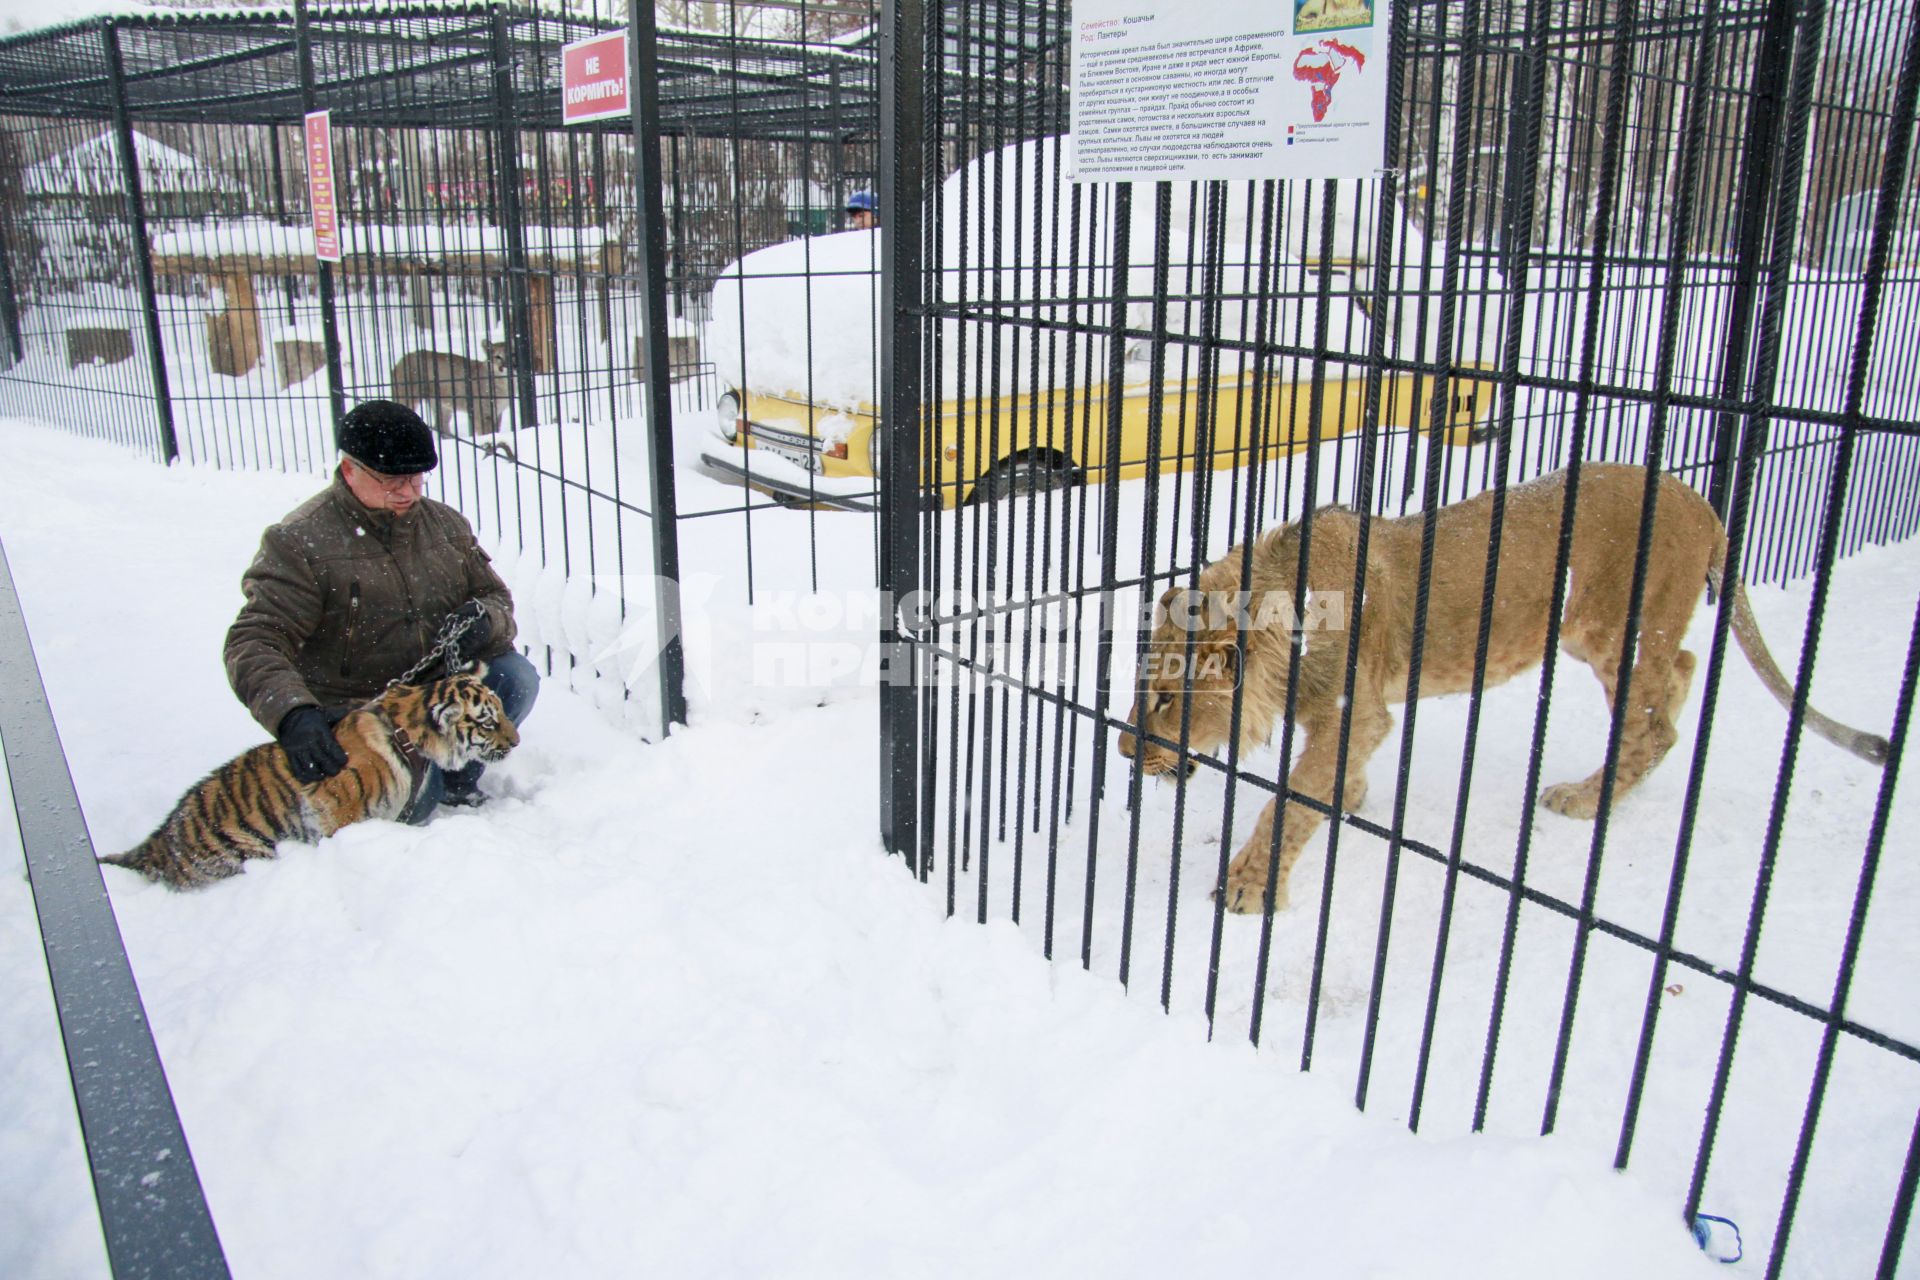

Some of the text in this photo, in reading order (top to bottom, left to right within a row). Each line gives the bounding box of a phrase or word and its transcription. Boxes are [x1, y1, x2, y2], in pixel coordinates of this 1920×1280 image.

[1123, 14, 1154, 24] Кошачьи
[1098, 30, 1128, 40] Пантеры
[1080, 48, 1120, 58] Исторический
[1121, 46, 1138, 54] ареал
[1172, 38, 1213, 48] значительно
[1215, 36, 1232, 44] шире
[1234, 30, 1284, 41] современного
[1128, 54, 1174, 65] средневековье
[1189, 48, 1226, 57] встречался
[585, 56, 600, 76] НЕ
[1088, 69, 1114, 77] Ближнем
[1168, 61, 1184, 70] даже
[1227, 55, 1249, 63] южной
[1229, 66, 1248, 74] могут
[567, 78, 624, 104] КОРМИТЬ!
[1079, 88, 1119, 97] перебираться
[1246, 75, 1274, 83] отличие
[1079, 108, 1106, 116] семейных
[1079, 119, 1115, 127] родственных
[1216, 110, 1250, 118] взрослых
[1227, 120, 1255, 128] случаев
[1202, 131, 1224, 140] людей
[1139, 144, 1160, 152] случаи
[1162, 142, 1201, 151] людоедства
